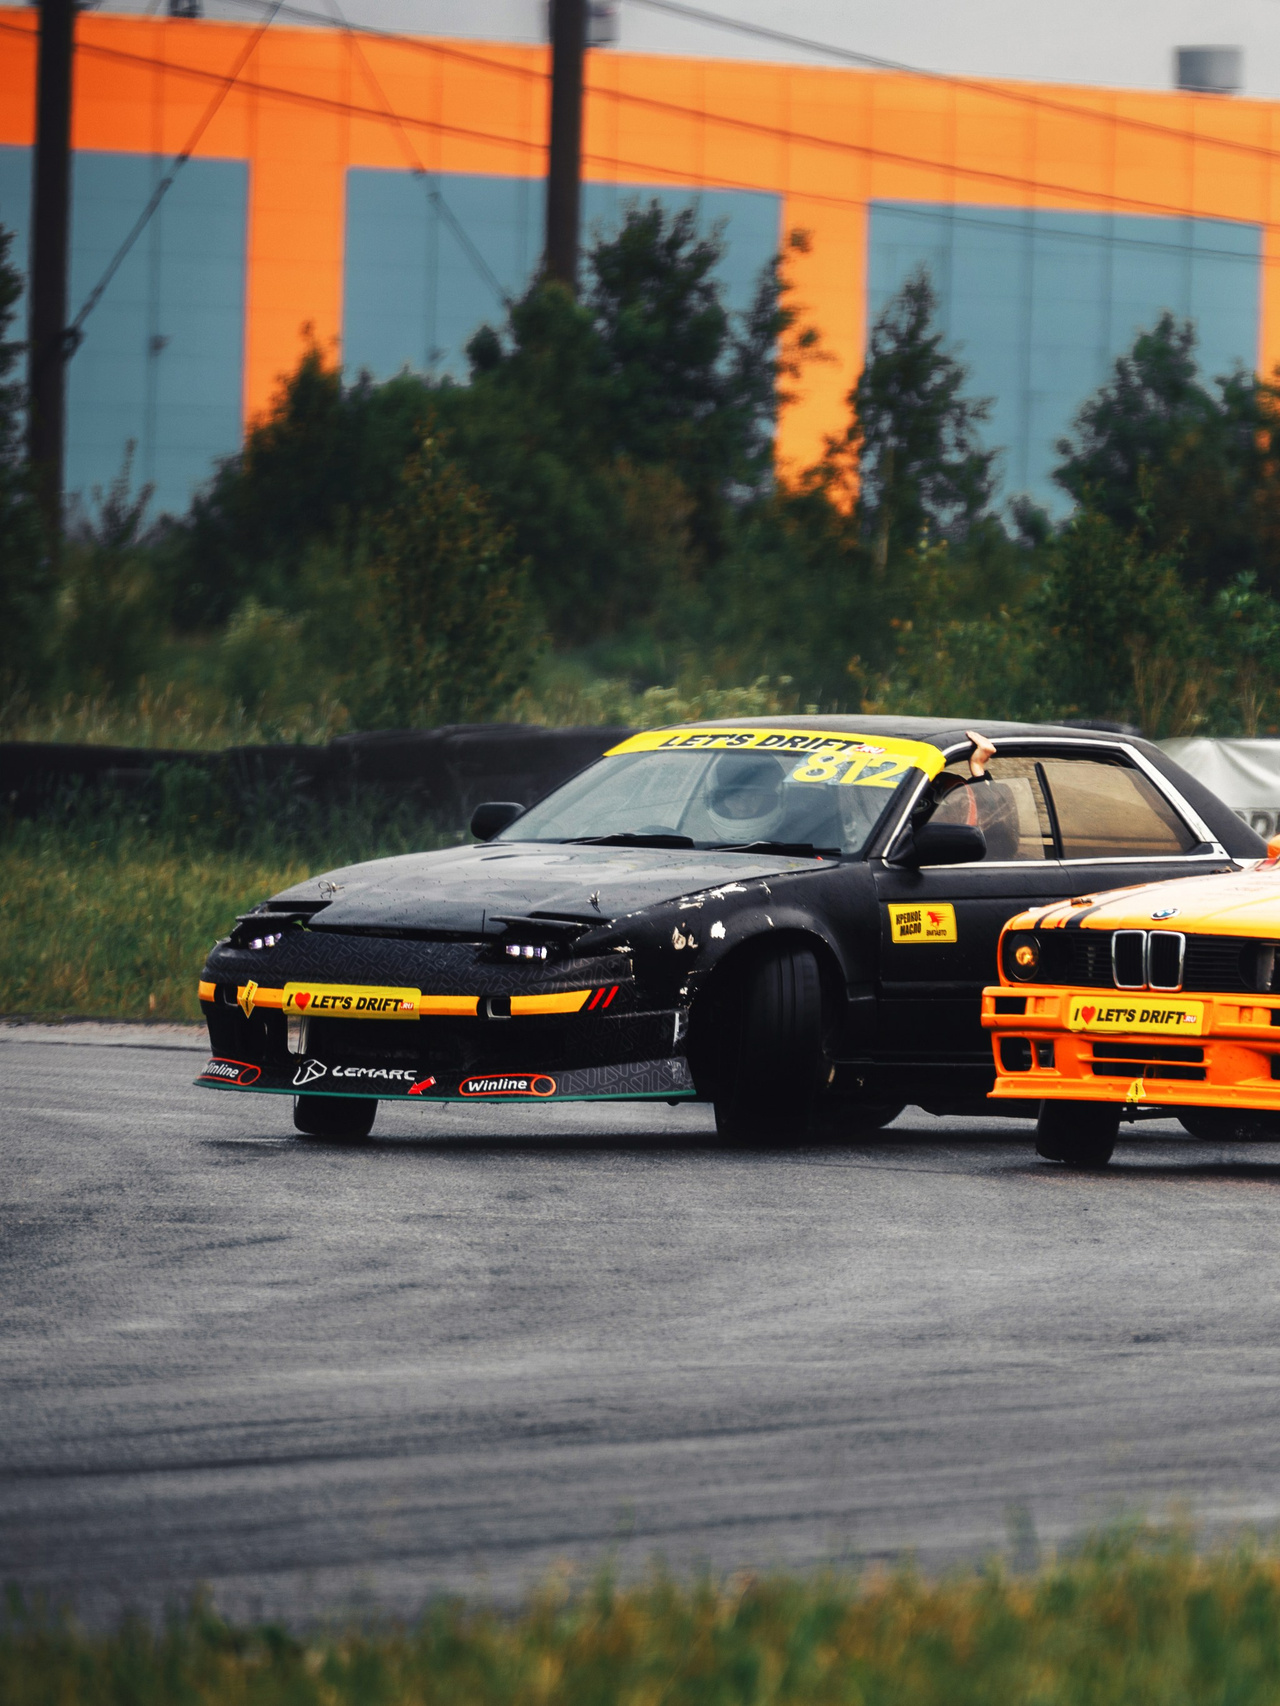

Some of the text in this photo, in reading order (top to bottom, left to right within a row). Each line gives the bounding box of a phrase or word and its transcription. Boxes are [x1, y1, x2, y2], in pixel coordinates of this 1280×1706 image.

[658, 734, 756, 749] LET'S
[793, 751, 914, 789] 812
[896, 910, 921, 925] КРЕПКОЕ
[900, 922, 922, 936] МАСЛО
[311, 995, 353, 1010] LET'S
[1096, 1008, 1136, 1022] LET'S
[332, 1065, 418, 1081] LEMARC
[468, 1078, 528, 1091] Winline
